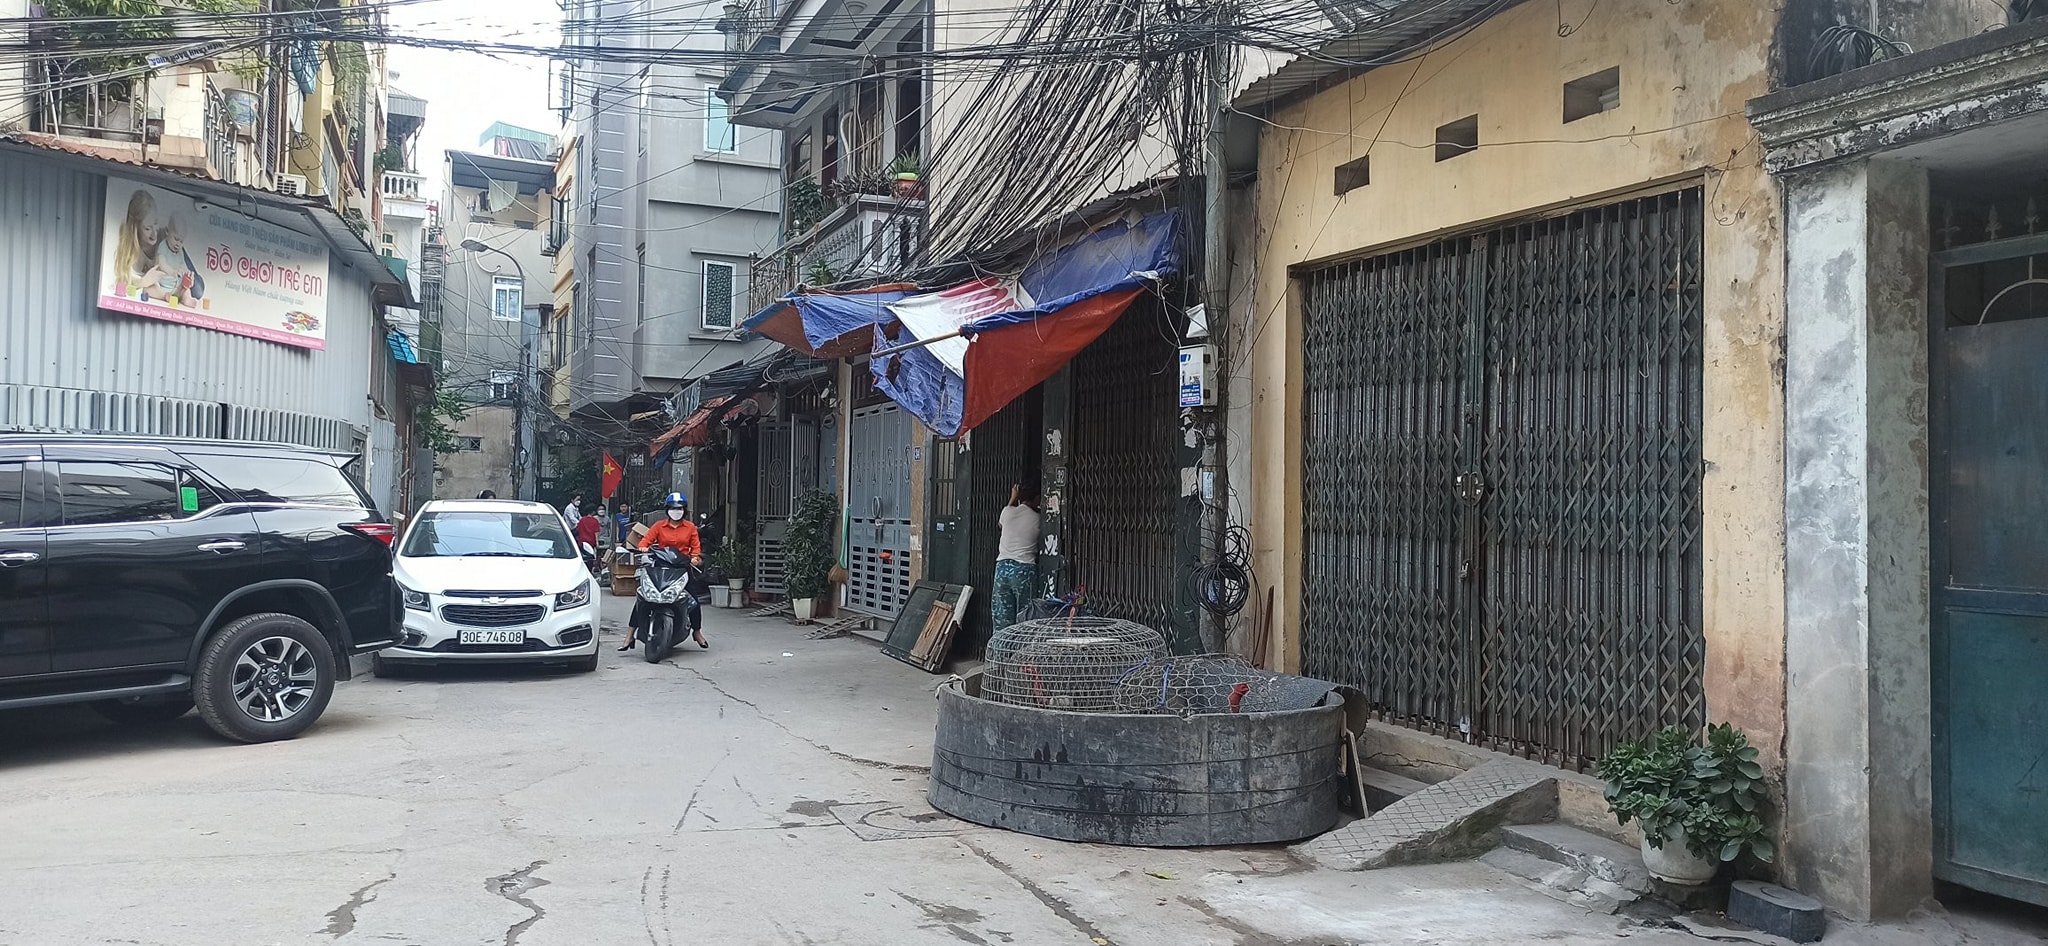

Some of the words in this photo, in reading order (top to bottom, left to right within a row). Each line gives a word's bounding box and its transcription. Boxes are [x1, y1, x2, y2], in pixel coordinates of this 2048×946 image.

[206, 243, 233, 274] ĐỒ
[237, 256, 274, 286] CHƠI
[277, 264, 301, 292] TRẺ
[303, 274, 322, 297] EM
